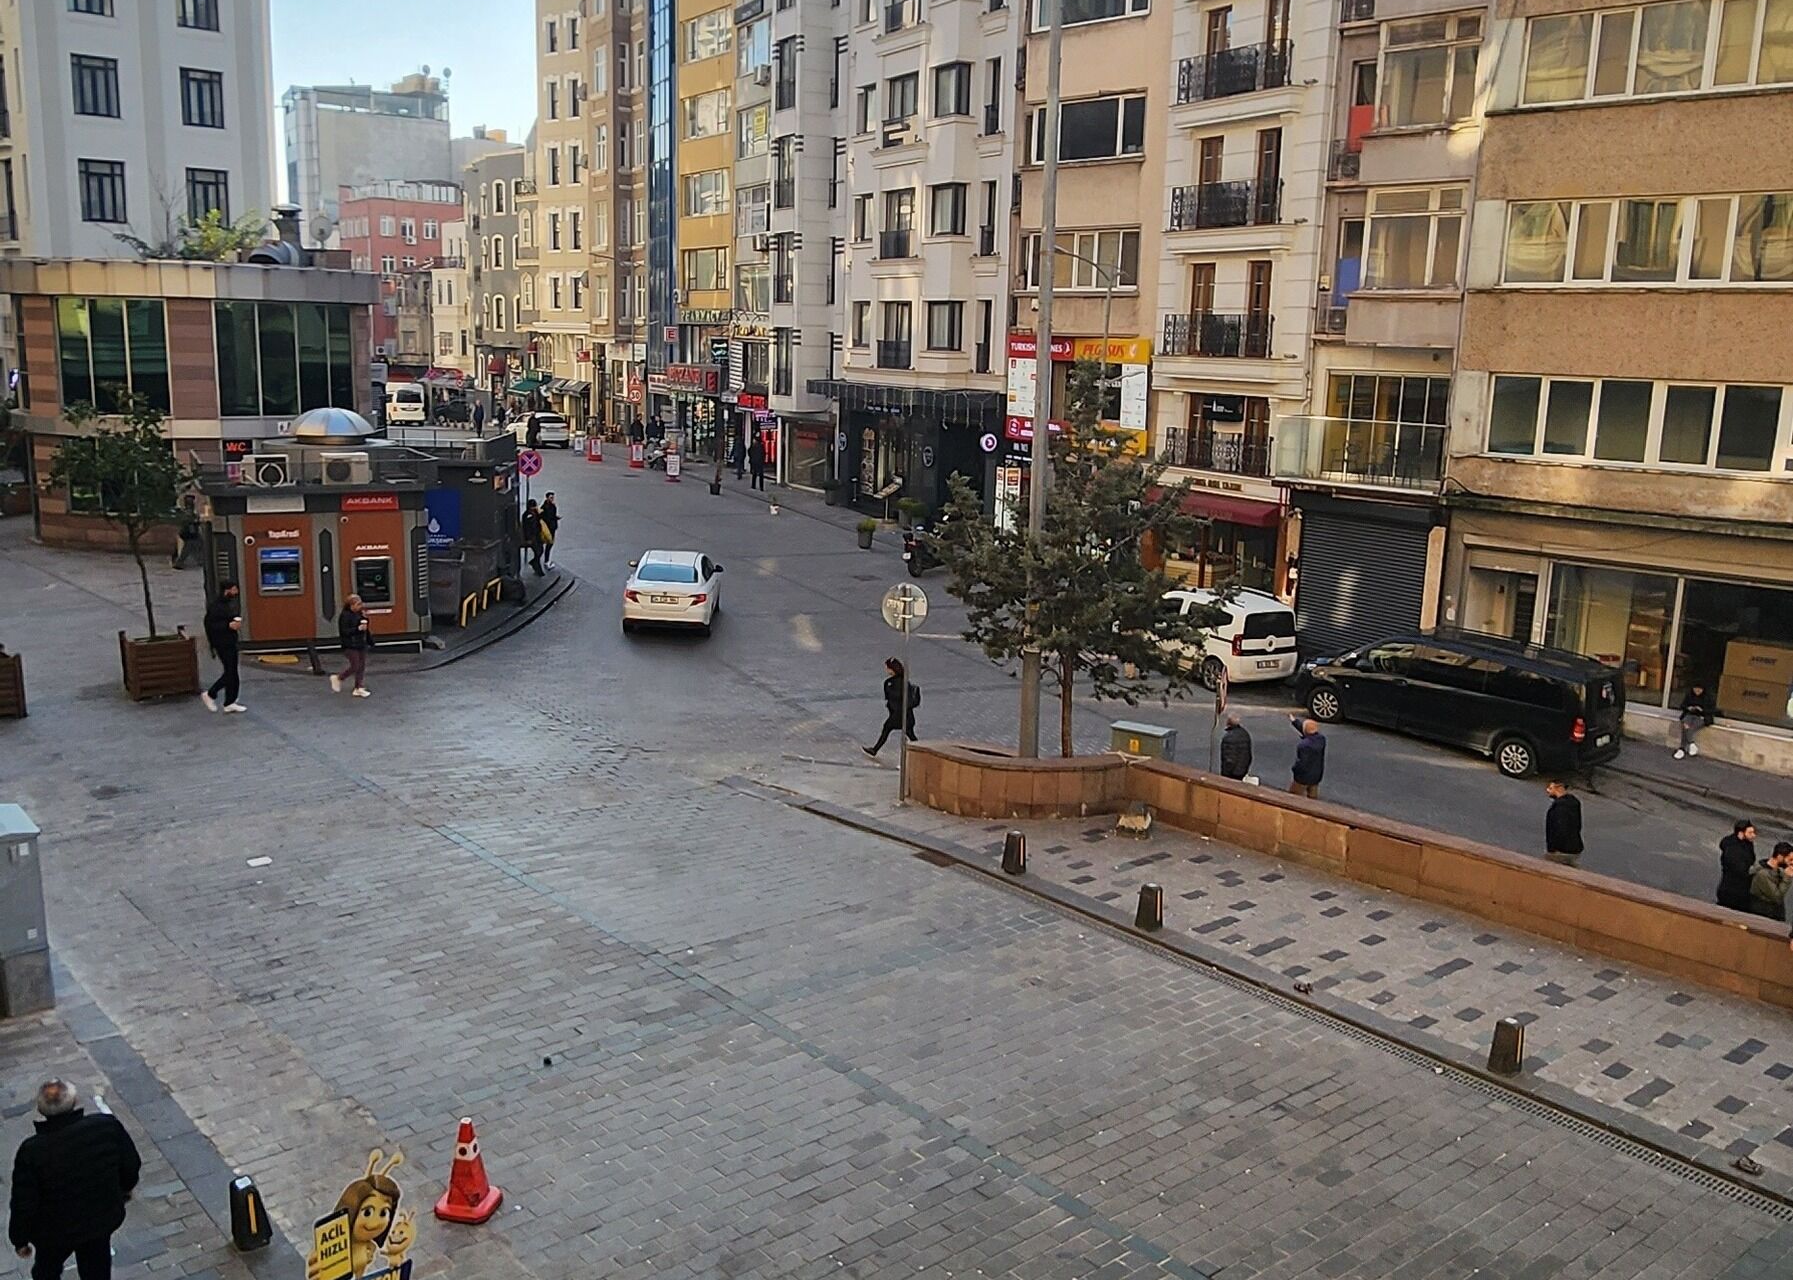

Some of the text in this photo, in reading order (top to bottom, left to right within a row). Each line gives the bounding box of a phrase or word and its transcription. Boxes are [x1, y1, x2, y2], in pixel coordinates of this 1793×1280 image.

[1011, 343, 1036, 352] TURKISH
[1083, 343, 1125, 358] PEGSUS
[630, 389, 641, 401] 30
[226, 441, 247, 452] WC
[346, 496, 393, 504] AKBANK
[320, 1238, 348, 1260] HIZLI
